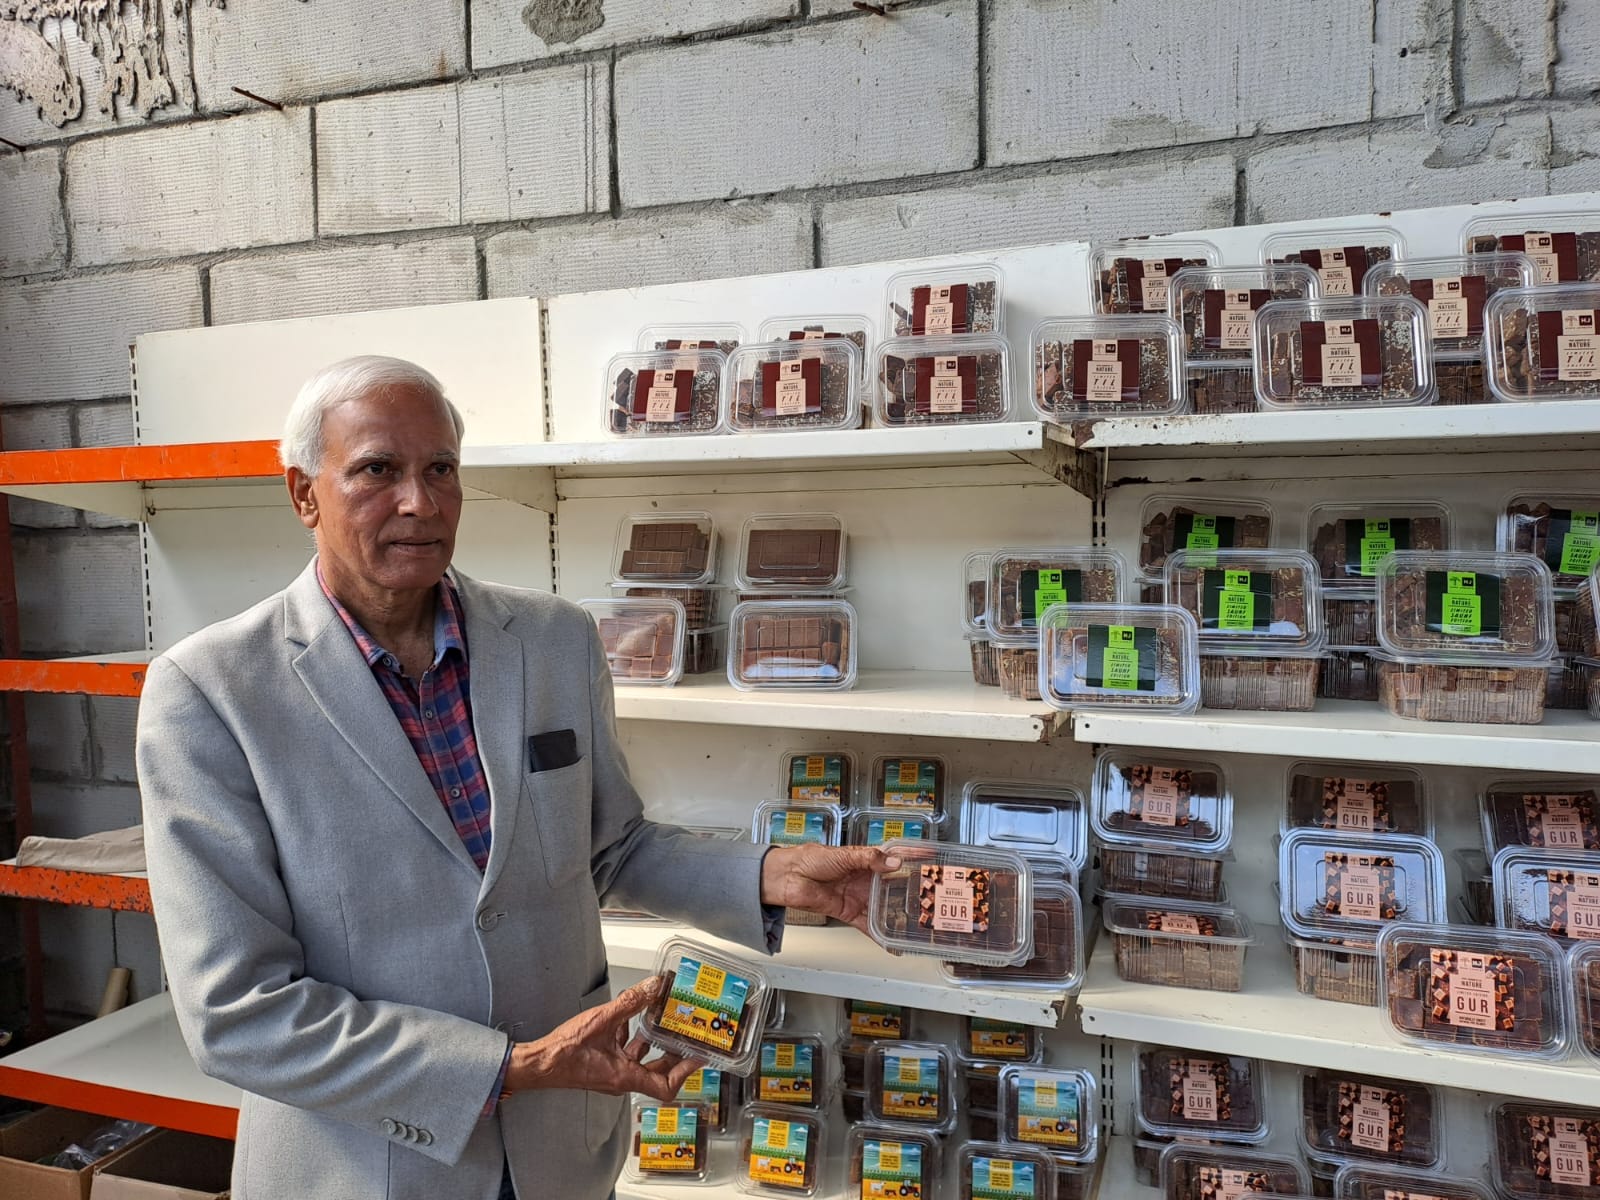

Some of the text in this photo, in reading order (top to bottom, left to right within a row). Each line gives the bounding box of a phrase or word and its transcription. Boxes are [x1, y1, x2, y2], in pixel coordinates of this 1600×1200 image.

[1149, 800, 1171, 813] GUR
[1343, 813, 1368, 826] GUR
[1550, 831, 1577, 843] GUR
[1347, 891, 1374, 906] GUR
[941, 904, 967, 918] GUR
[1461, 980, 1482, 989] NATURE
[1457, 996, 1488, 1014] GUR
[1189, 1096, 1212, 1108] GUR
[1358, 1122, 1383, 1138] GUR
[1556, 1157, 1583, 1173] GUR
